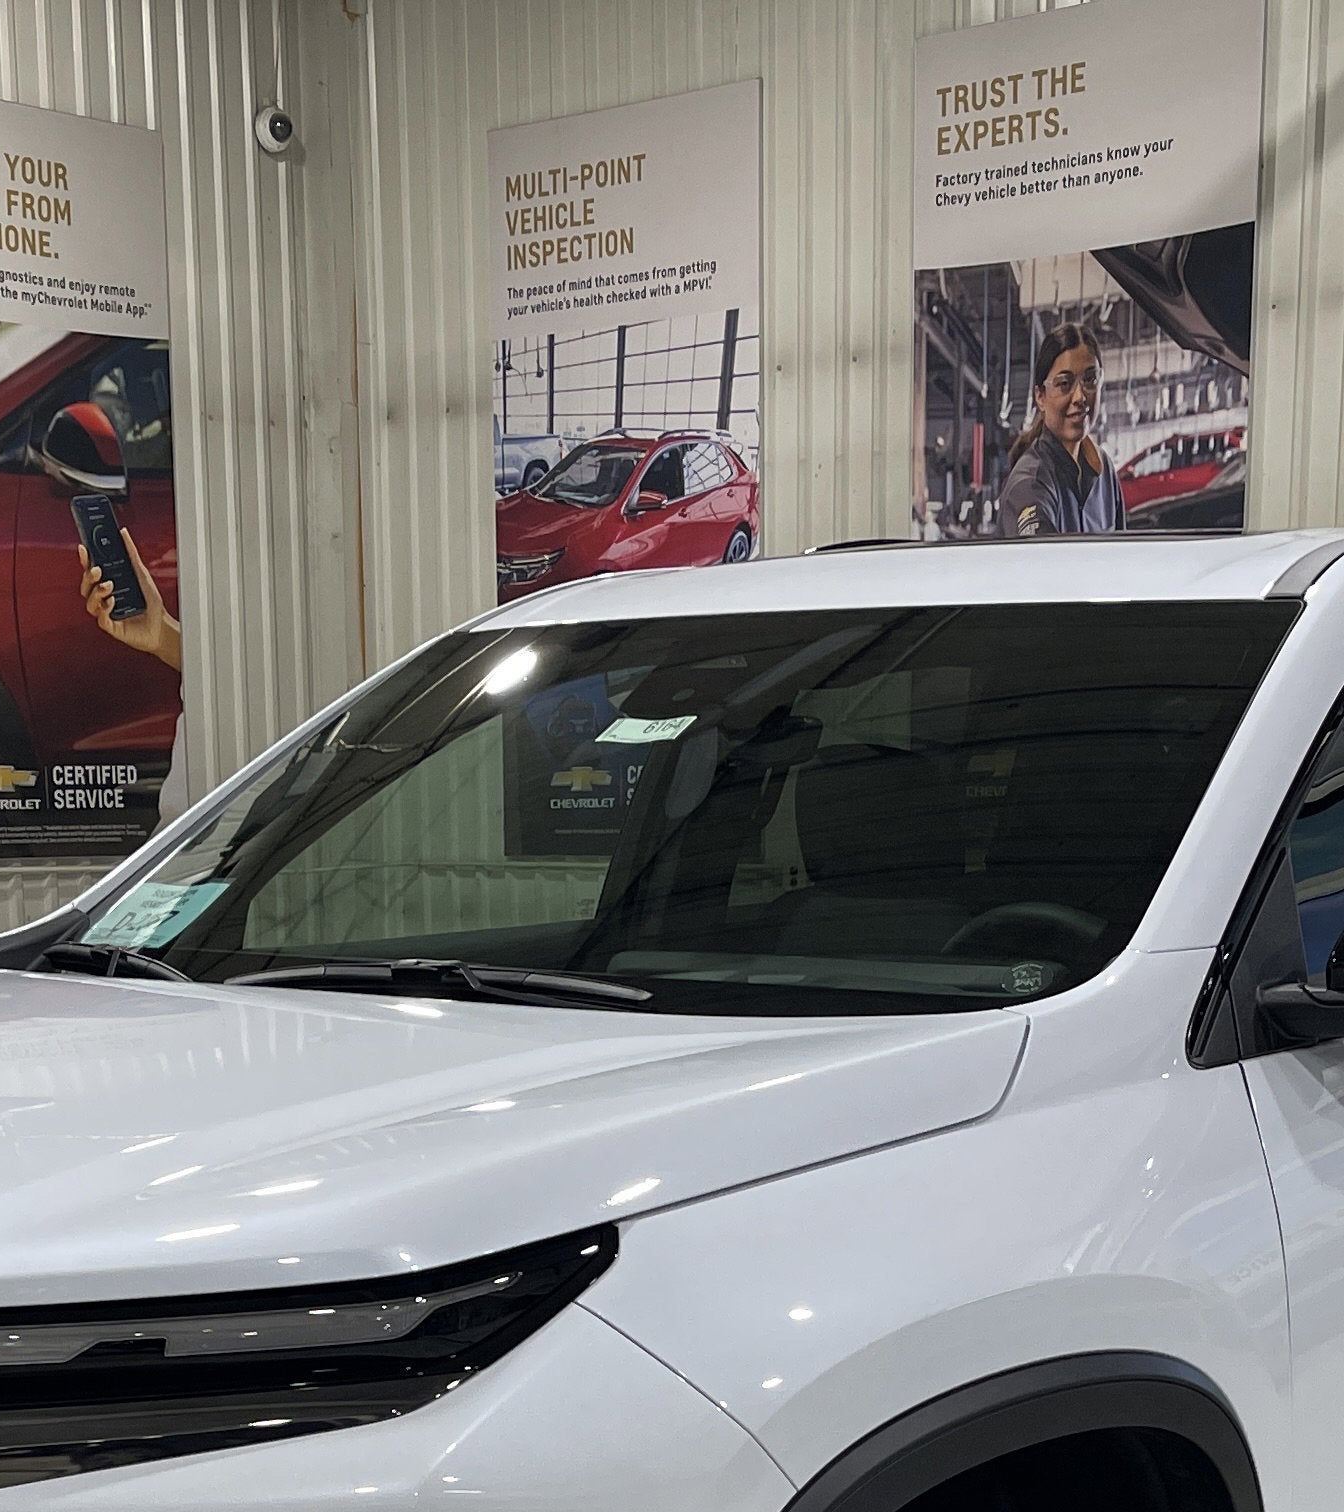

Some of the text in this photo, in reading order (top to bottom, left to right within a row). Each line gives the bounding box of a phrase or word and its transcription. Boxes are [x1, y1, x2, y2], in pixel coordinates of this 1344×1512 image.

[936, 61, 1086, 117] TRUST THE
[936, 107, 1069, 156] EXPERTS.
[4, 152, 69, 191] YOUR
[505, 153, 646, 202] MULTI-POINT
[935, 137, 1174, 189] Factory trained technicians know your
[935, 166, 1144, 207] Chevy vehicle better than anyone.
[6, 188, 73, 226] FROM
[505, 198, 595, 236] VEHICLE
[507, 227, 635, 271] INSPECTION
[47, 276, 66, 290] and
[68, 280, 97, 297] enjoy
[99, 284, 136, 298] remote
[507, 259, 717, 300] The peace of mind that comes from getting
[0, 285, 19, 301] the
[21, 290, 88, 311] myChevrolet
[90, 300, 123, 315] Mobile
[507, 306, 528, 320] your
[530, 297, 571, 315] vehicle's
[573, 294, 604, 309] health
[606, 288, 647, 305] checked
[649, 283, 672, 299] with
[674, 284, 681, 295] a
[52, 765, 138, 786] CERTIFIED
[54, 788, 125, 809] SERVICE
[550, 797, 616, 809] CHEVROLET
